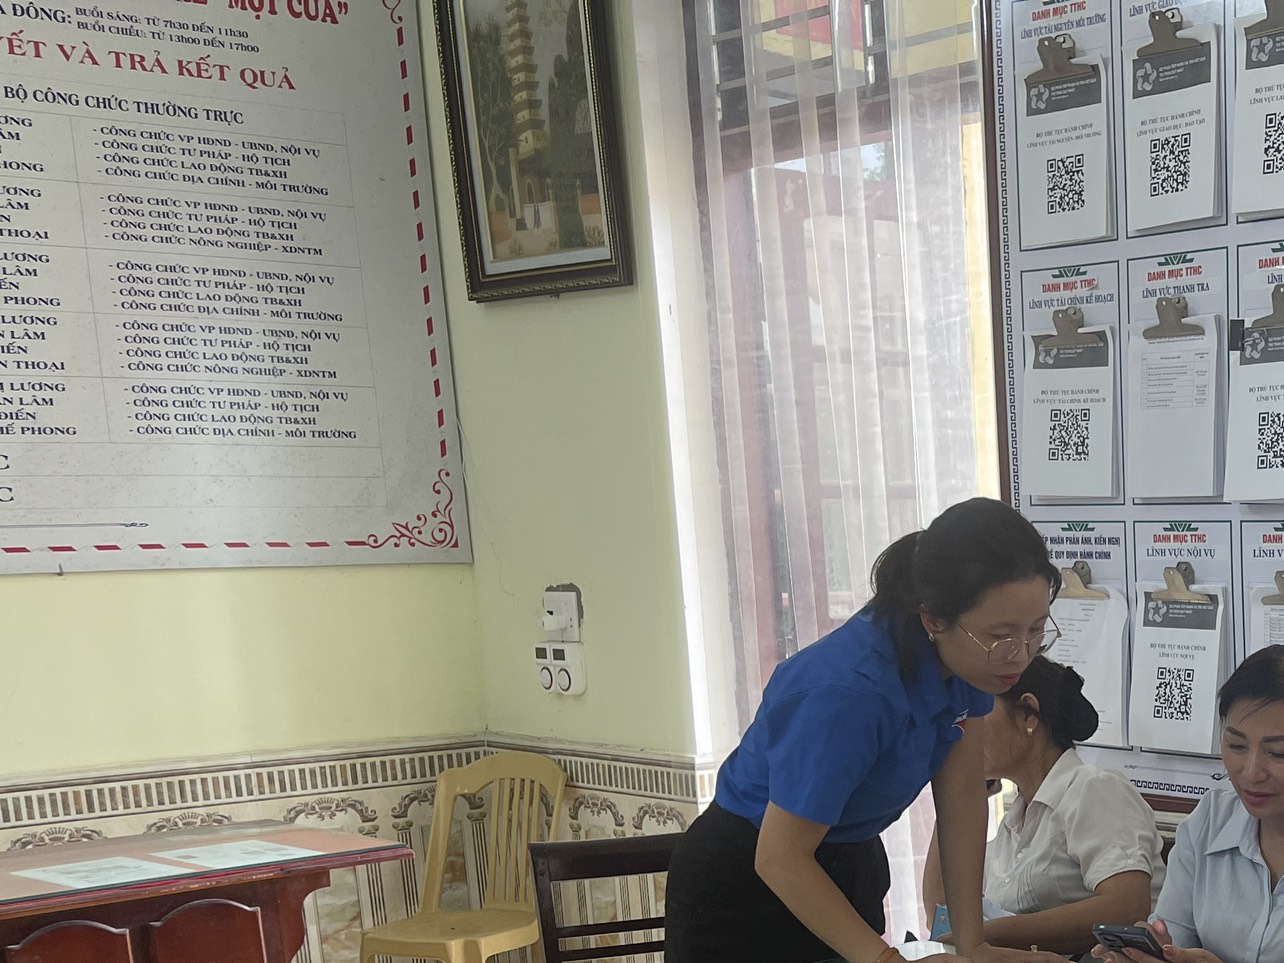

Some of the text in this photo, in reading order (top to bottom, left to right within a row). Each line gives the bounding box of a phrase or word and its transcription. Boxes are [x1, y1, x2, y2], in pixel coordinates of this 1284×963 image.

[11, 1, 72, 24] ĐÔNG:
[75, 5, 249, 38] BUỔI SÁNG: TỪ 7h30 ĐẾN 11h30
[76, 19, 259, 53] BUỔI CHIỀU: TỪ 13h00 ĐẾN 17h00
[55, 41, 100, 66] VÀ
[107, 50, 168, 74] TRẢ
[176, 54, 230, 81] KẾT
[239, 66, 295, 89] QUẢ
[3, 83, 243, 126] BỘ CÔNG CHỨC THƯỜNG TRỰC
[1147, 265, 1202, 282] DANH MỤC TTHC
[13, 360, 65, 372] THOẠI
[9, 381, 65, 392] LƯƠNG
[18, 394, 54, 406] LÂM
[20, 426, 76, 435] PHONG
[1262, 533, 1282, 543] DANH
[1146, 543, 1215, 559] LĨNH VỰC NỘI VỤ
[1252, 546, 1275, 558] LĨNH
